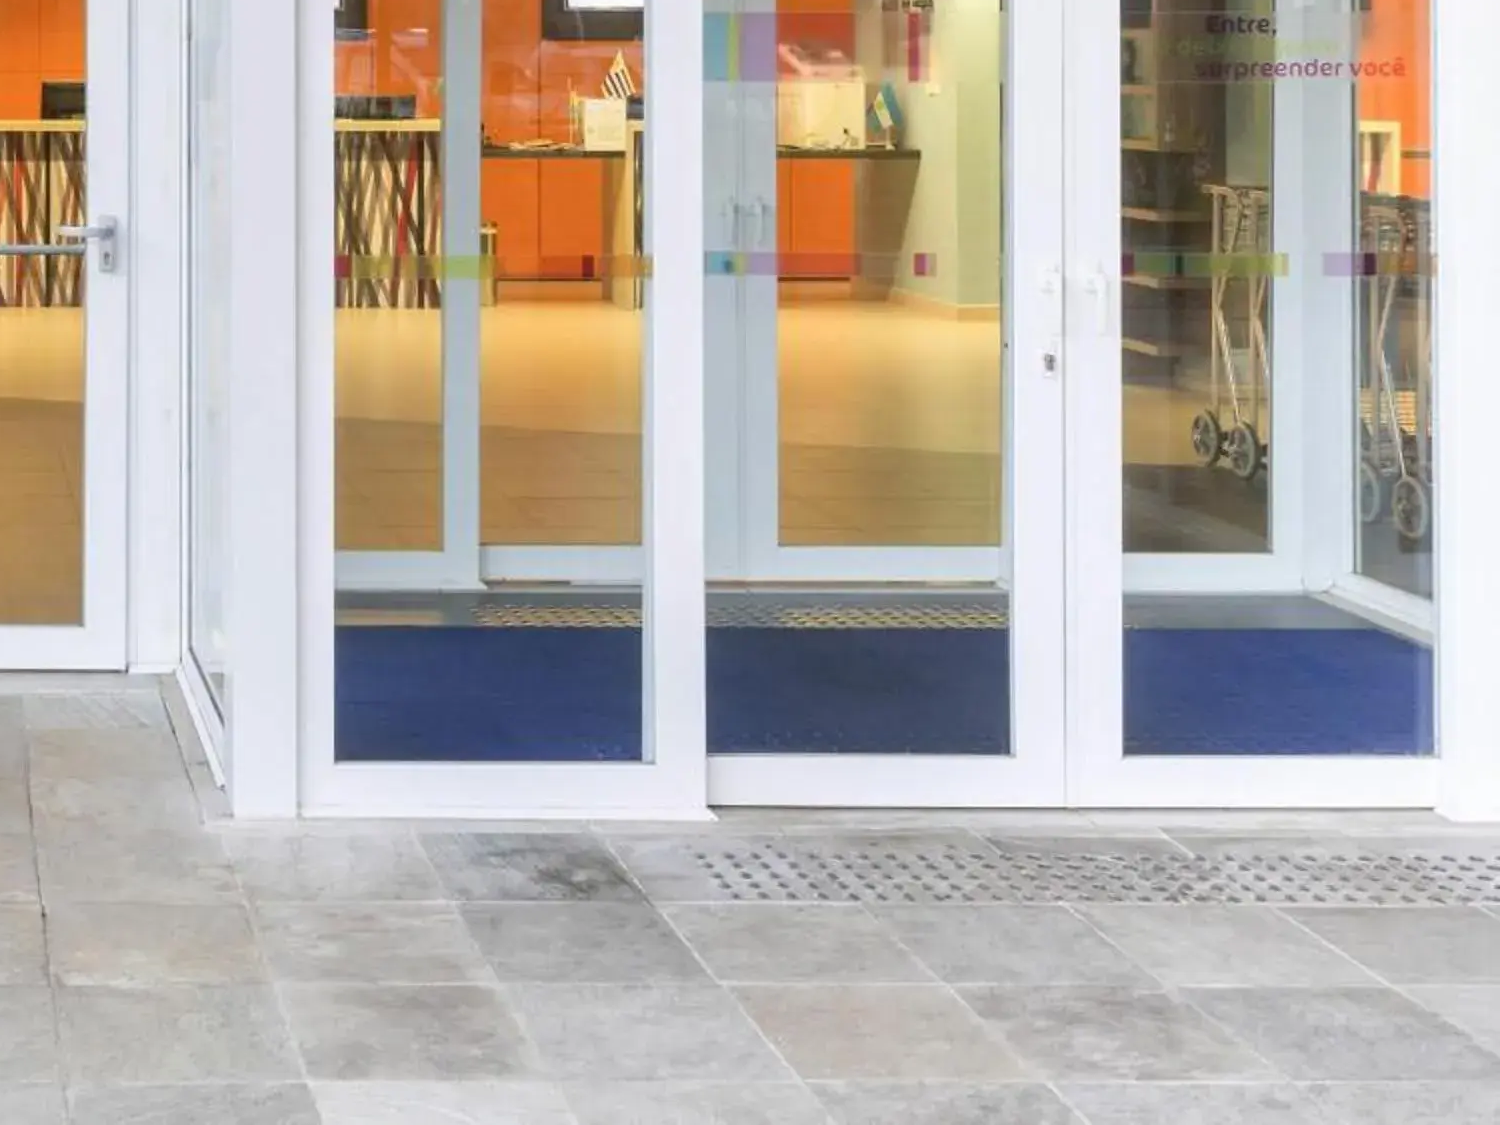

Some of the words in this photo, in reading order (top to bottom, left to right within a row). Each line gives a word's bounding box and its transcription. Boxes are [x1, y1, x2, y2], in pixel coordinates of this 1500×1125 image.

[1205, 15, 1277, 35] Entre,
[1195, 58, 1343, 80] surpreender
[1350, 57, 1406, 77] você
